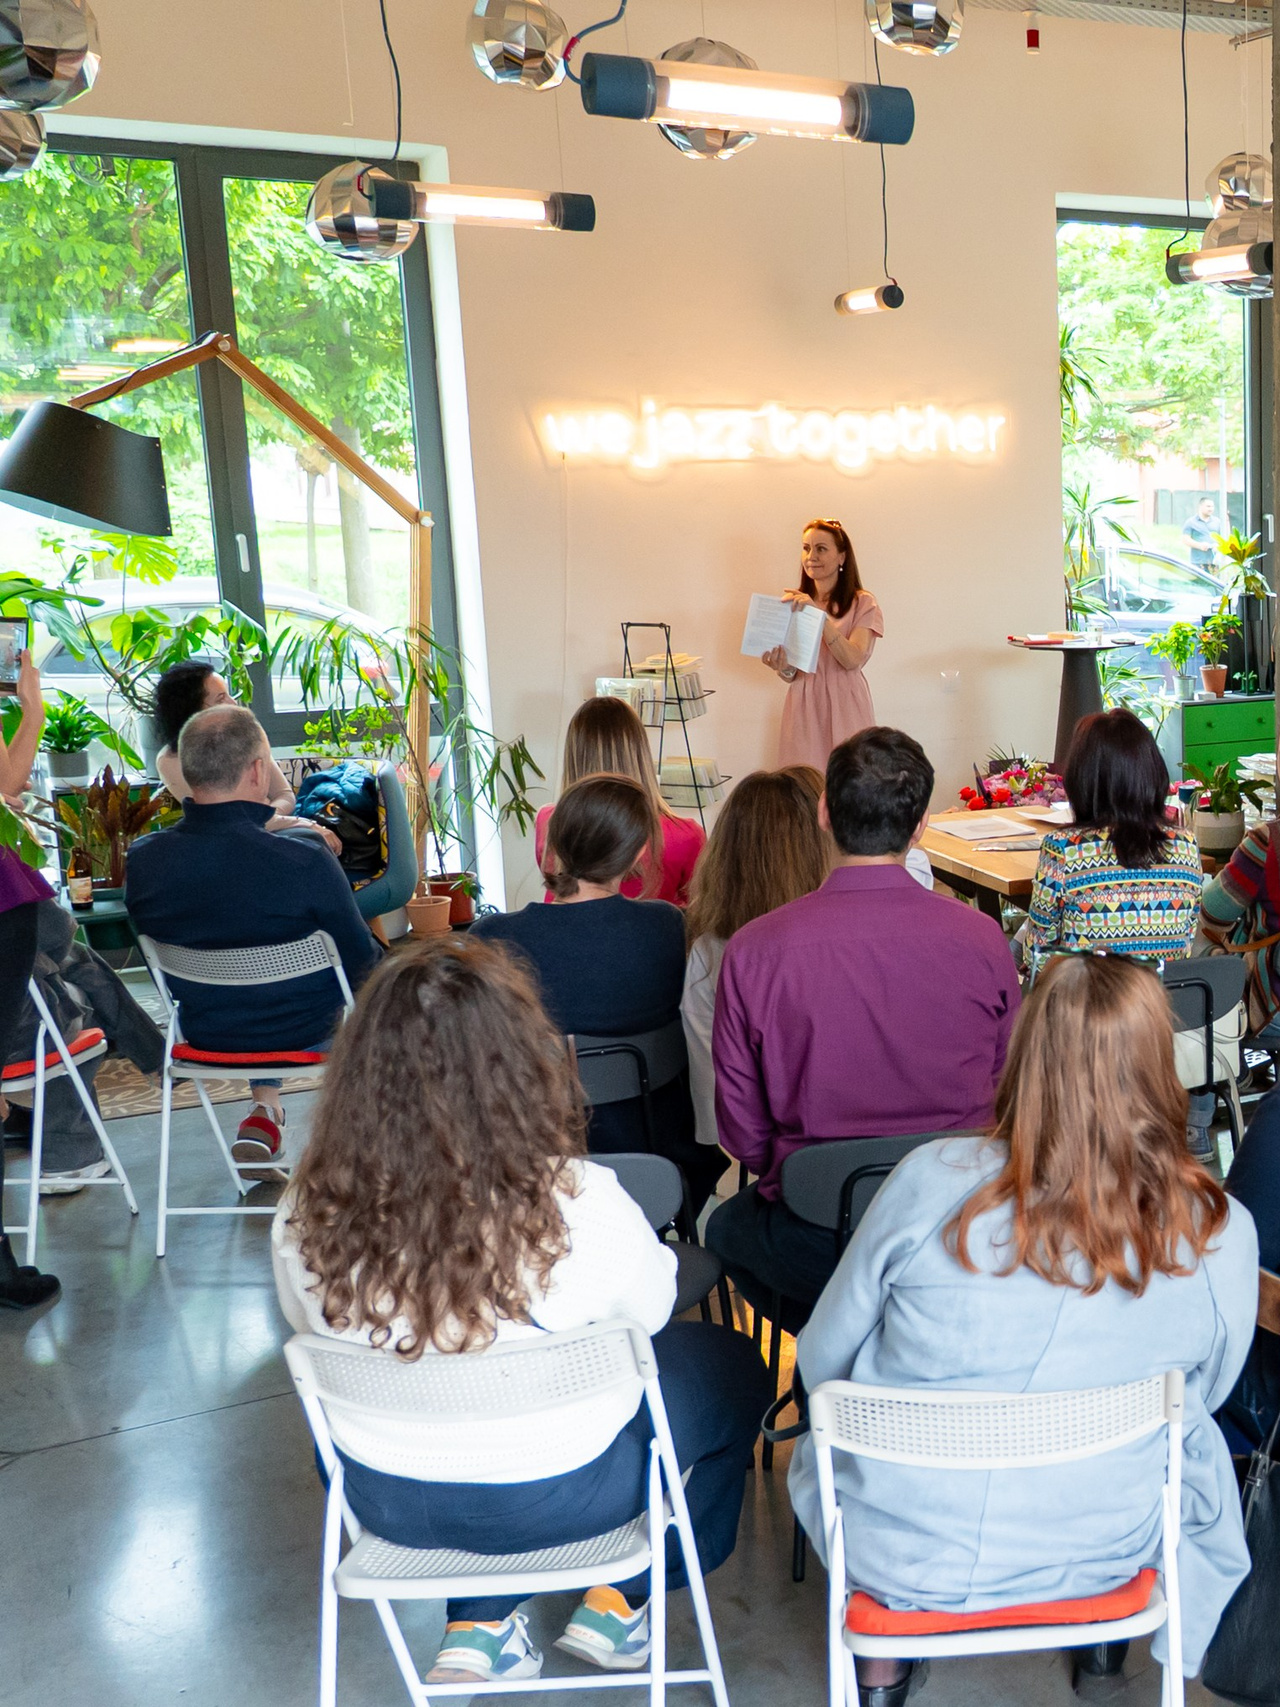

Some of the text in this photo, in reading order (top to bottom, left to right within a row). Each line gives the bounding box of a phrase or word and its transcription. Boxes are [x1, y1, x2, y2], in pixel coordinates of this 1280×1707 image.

[545, 400, 1005, 468] we jazz together
